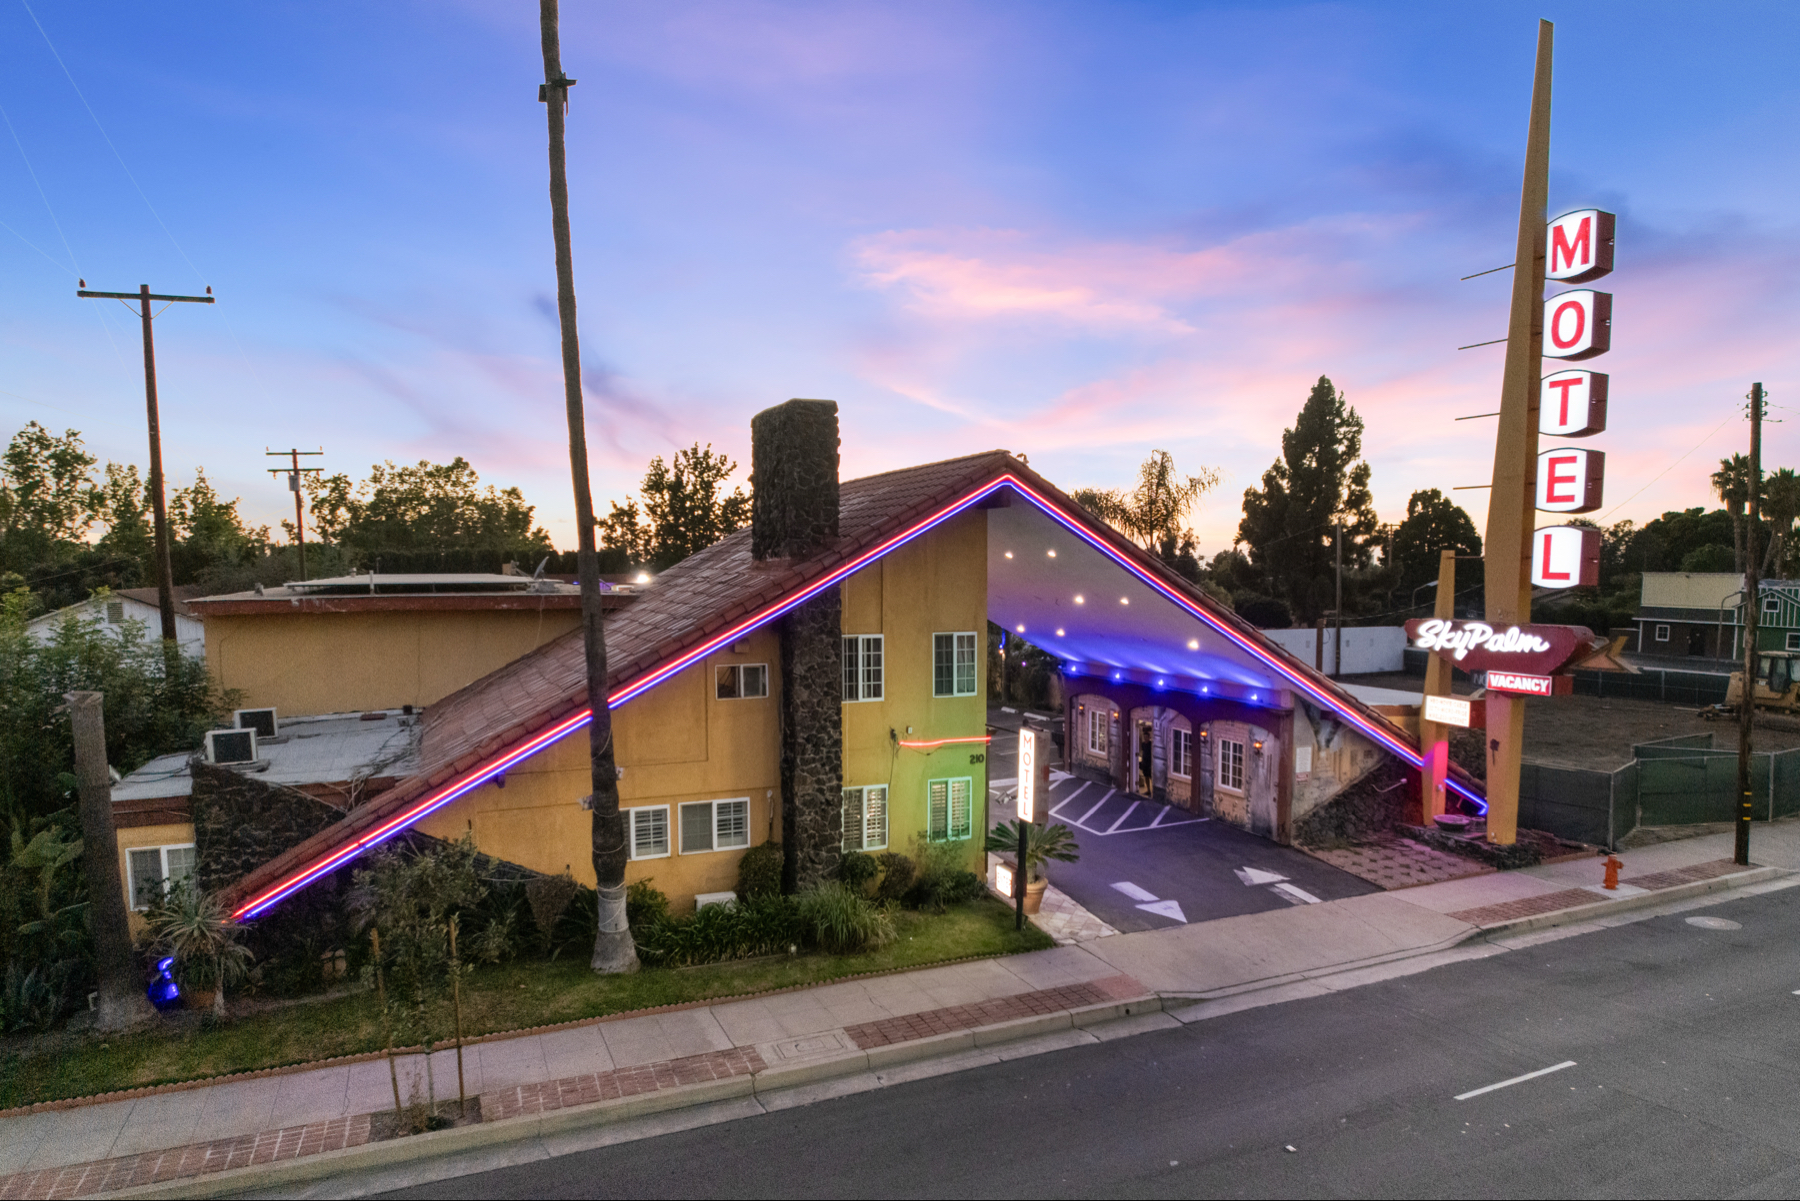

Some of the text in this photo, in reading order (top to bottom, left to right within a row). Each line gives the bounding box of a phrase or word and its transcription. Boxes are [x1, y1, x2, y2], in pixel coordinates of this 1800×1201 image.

[1542, 216, 1592, 580] MOTEL
[1490, 674, 1549, 692] VACANCY
[969, 754, 984, 764] 210
[1022, 734, 1032, 815] MOTEL
